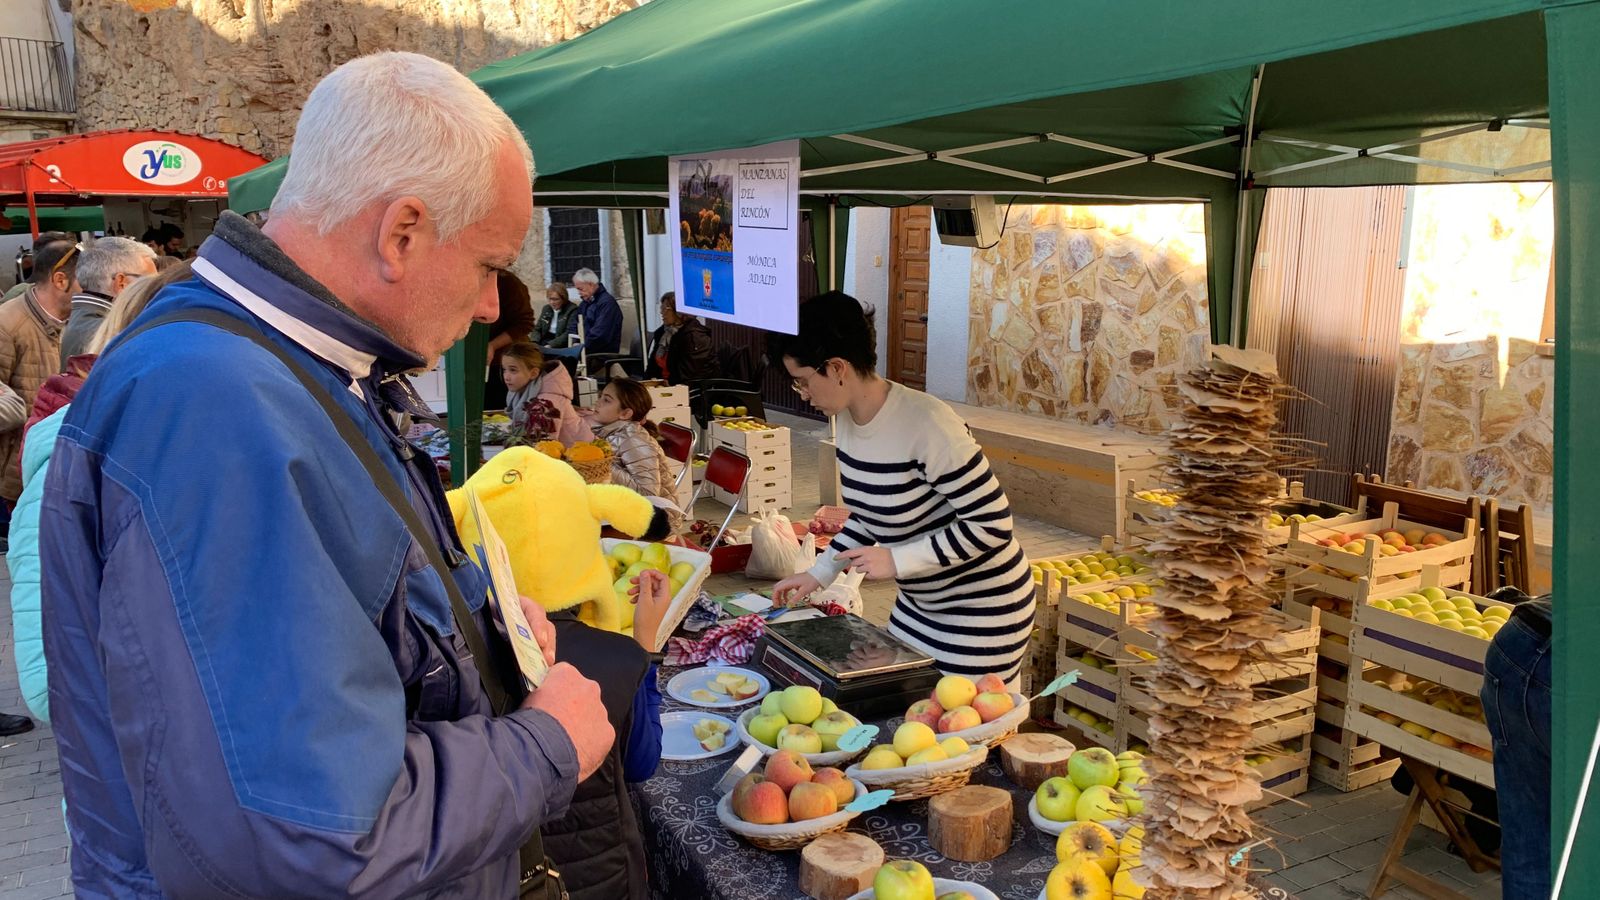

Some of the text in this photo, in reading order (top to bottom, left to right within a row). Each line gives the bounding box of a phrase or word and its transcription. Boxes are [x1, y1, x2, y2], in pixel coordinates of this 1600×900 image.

[140, 149, 182, 179] Yus
[741, 168, 787, 180] MANZANAS
[740, 188, 755, 199] DEL
[740, 205, 771, 219] RINCÓN
[747, 255, 777, 268] MÓNICA
[748, 272, 777, 286] ADALID
